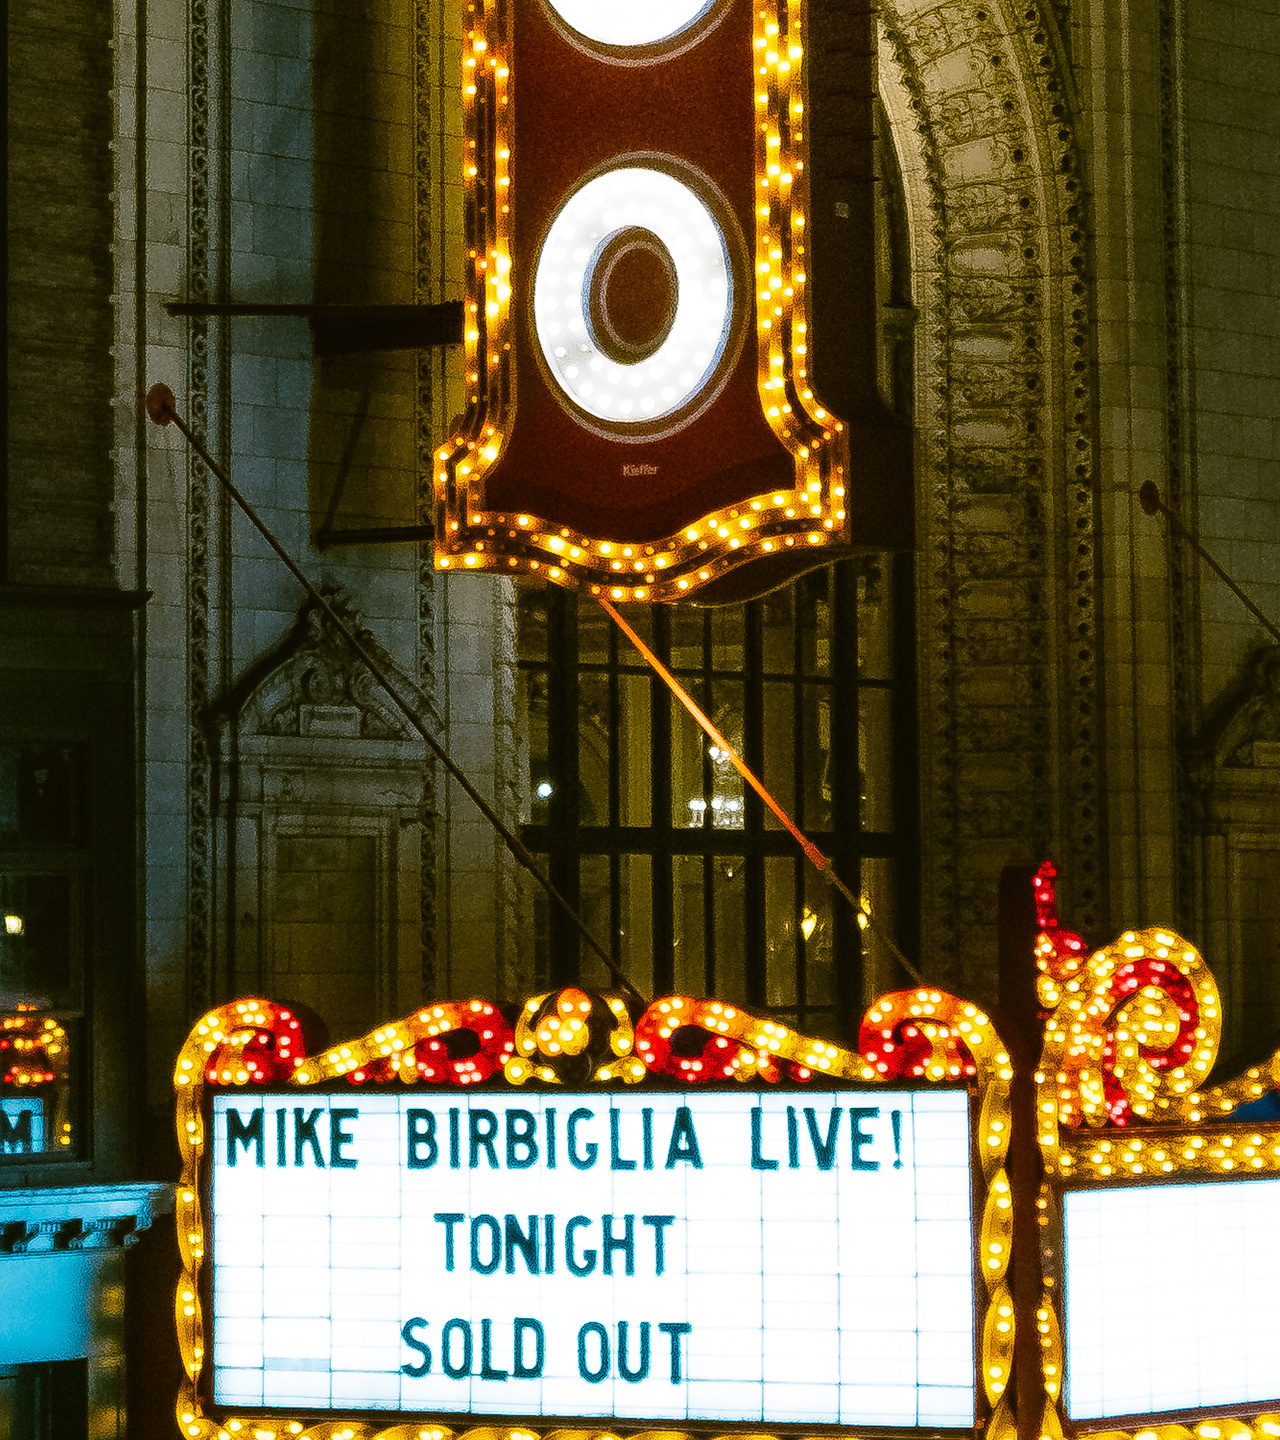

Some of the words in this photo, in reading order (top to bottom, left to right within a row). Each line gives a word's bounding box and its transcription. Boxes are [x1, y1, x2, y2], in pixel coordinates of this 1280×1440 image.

[225, 1106, 360, 1170] MIKE
[405, 1106, 704, 1171] BIRBIGLIA
[750, 1105, 904, 1172] LIVE!
[433, 1212, 676, 1277] TONIGHT
[400, 1317, 546, 1381] SOLD
[577, 1320, 693, 1386] OUT
